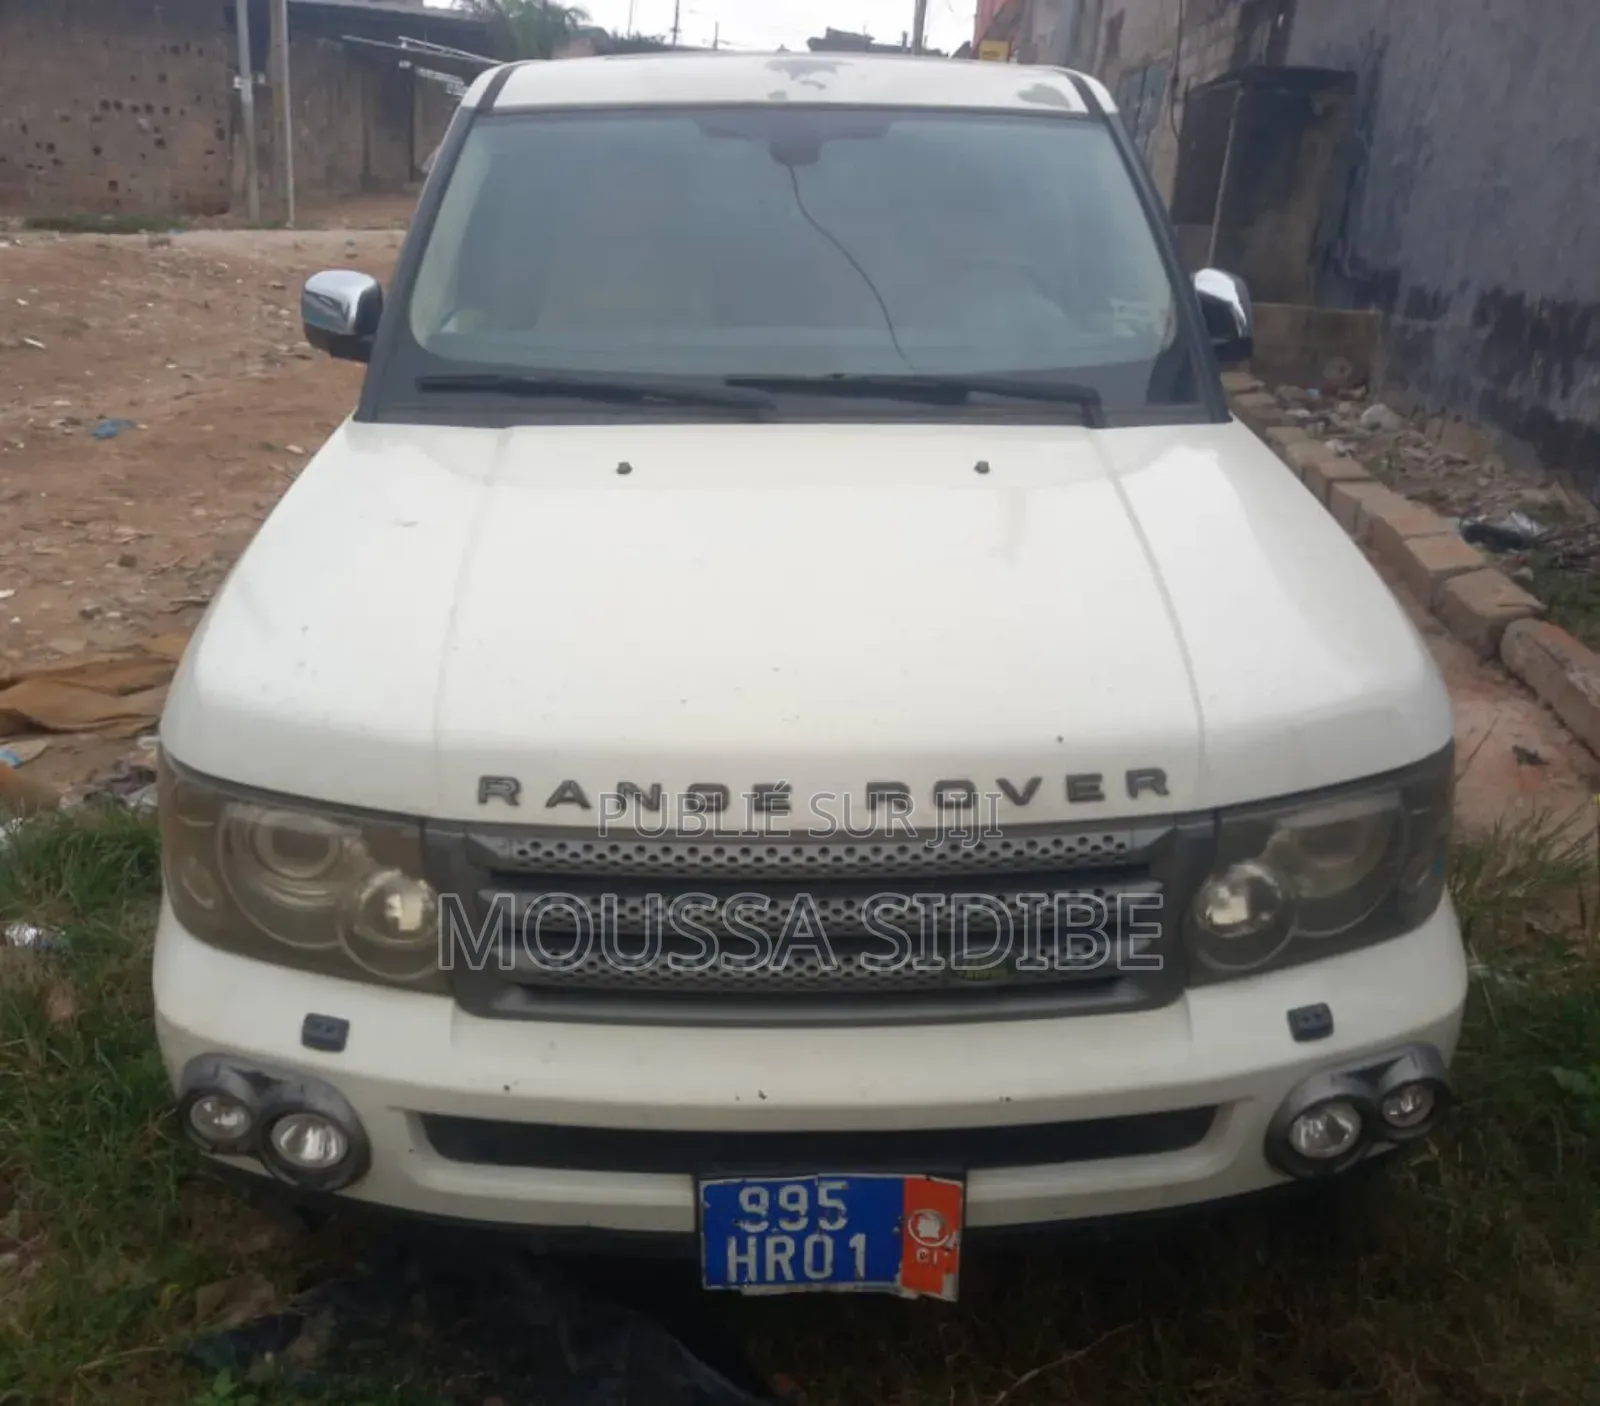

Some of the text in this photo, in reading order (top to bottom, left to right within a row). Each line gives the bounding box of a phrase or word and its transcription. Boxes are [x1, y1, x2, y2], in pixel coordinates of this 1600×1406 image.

[477, 768, 1171, 812] RANGE ROVER
[738, 1181, 848, 1232] 995
